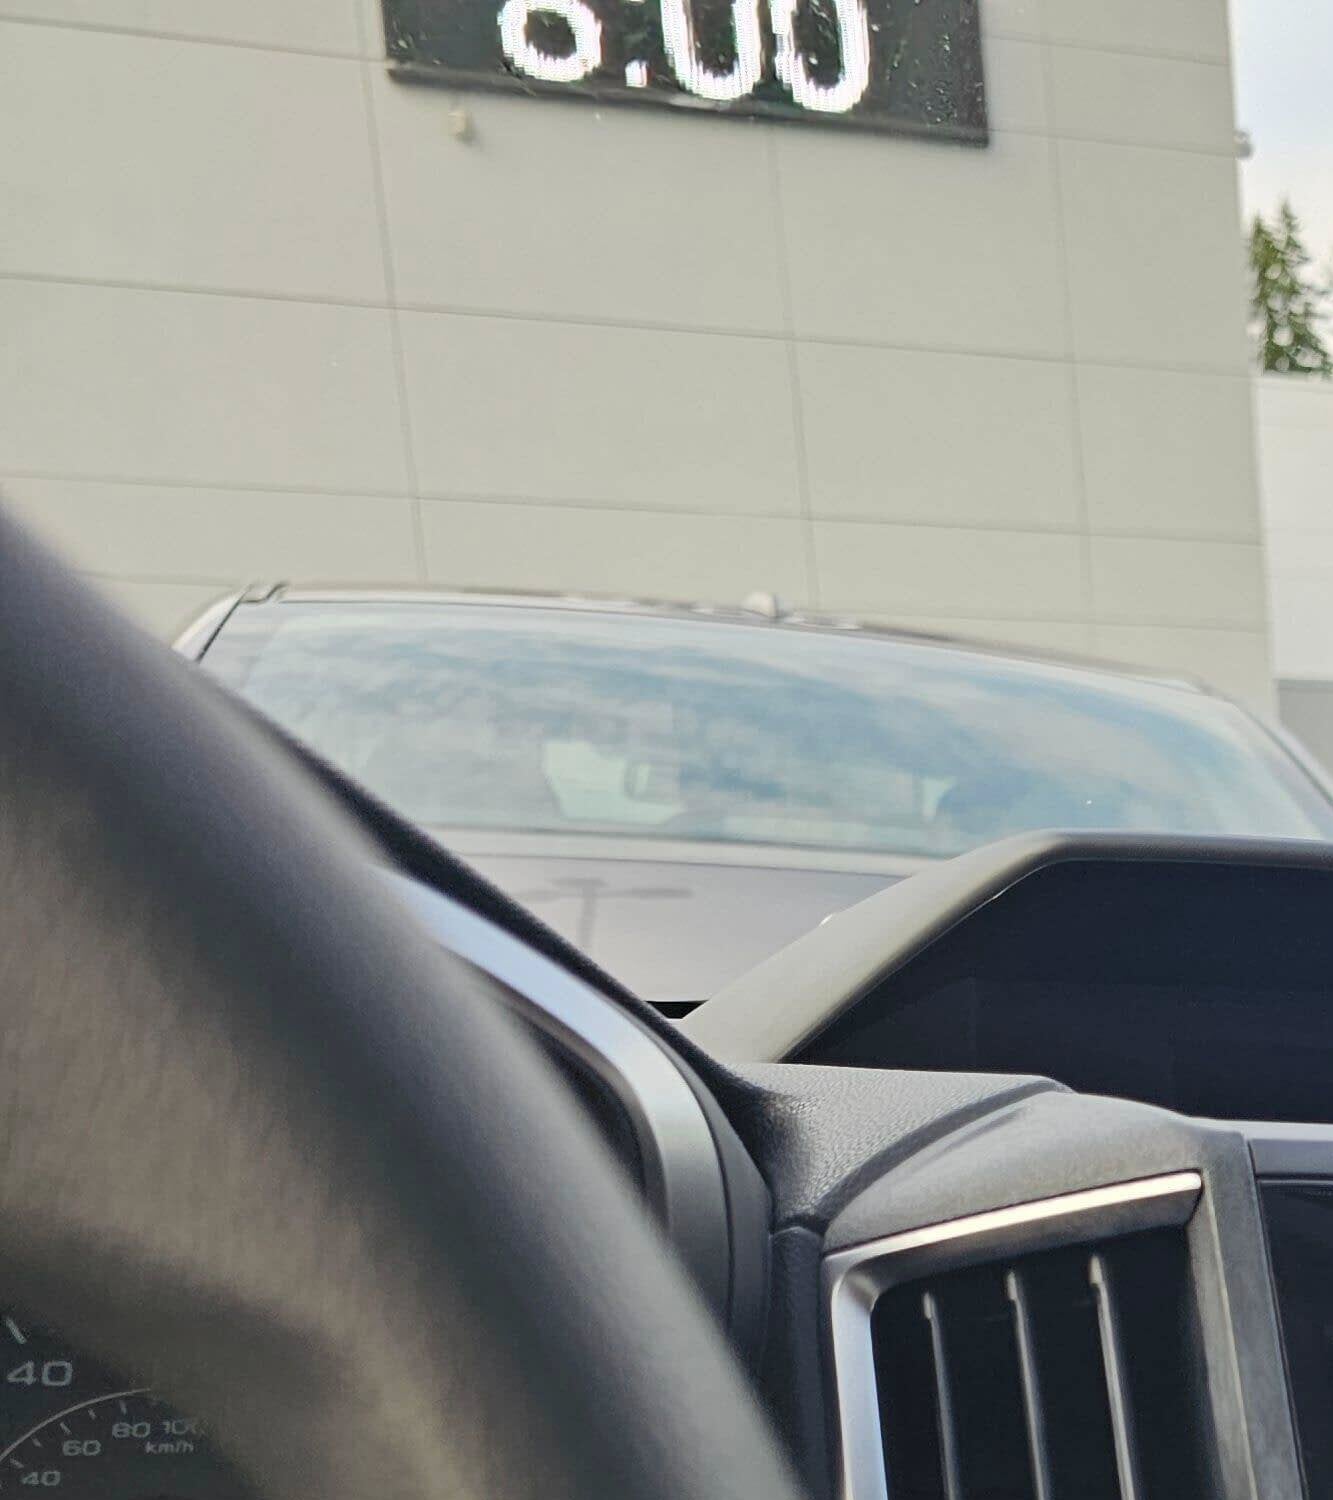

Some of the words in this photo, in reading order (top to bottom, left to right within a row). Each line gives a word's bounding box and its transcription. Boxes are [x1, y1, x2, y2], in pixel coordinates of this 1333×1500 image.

[7, 1360, 74, 1386] 40
[62, 1440, 102, 1456] 60
[145, 1442, 194, 1453] km/h
[21, 1470, 61, 1486] 40
